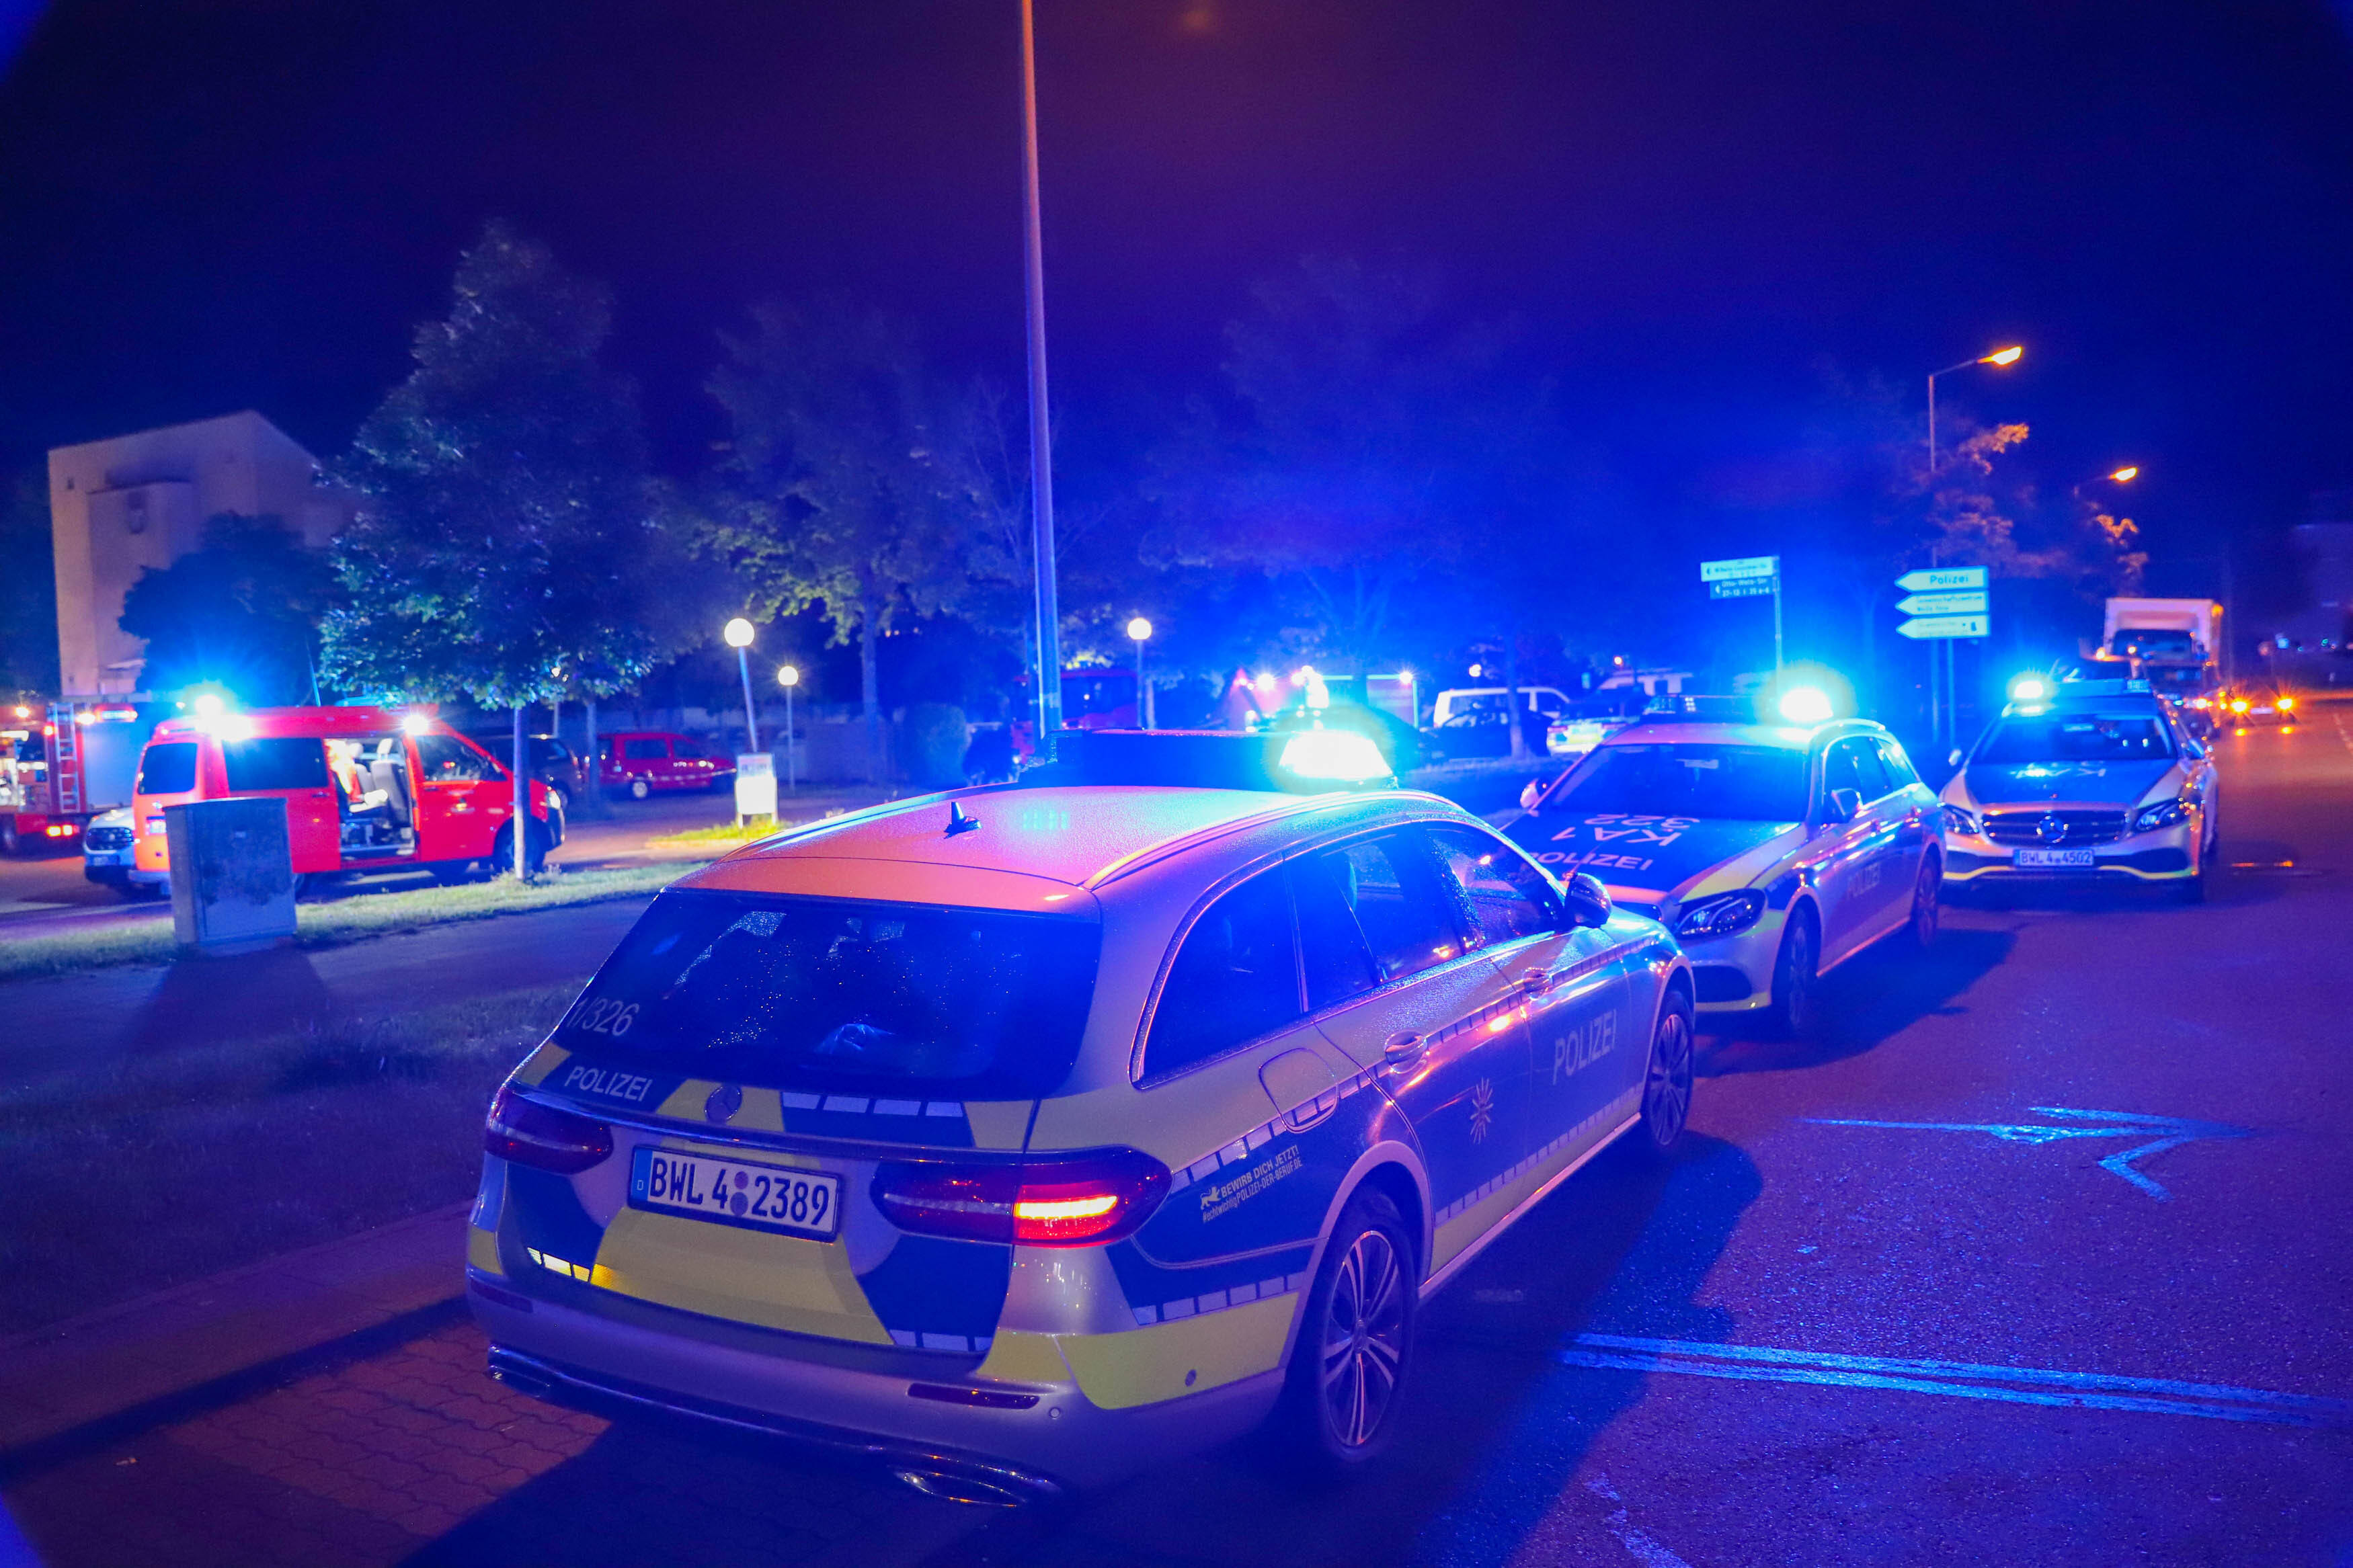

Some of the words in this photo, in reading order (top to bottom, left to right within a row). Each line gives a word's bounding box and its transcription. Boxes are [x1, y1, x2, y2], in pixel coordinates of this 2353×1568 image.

[1929, 575, 1968, 585] Polizei
[1584, 813, 1700, 829] 322
[1594, 827, 1682, 846] KA
[567, 997, 640, 1036] 1/326
[1553, 1009, 1617, 1085] POLIZEI
[564, 1066, 653, 1102] POLIZEI
[637, 1180, 644, 1191] D
[1221, 1172, 1253, 1198] BEWIRB
[1253, 1159, 1273, 1179] DICH
[1275, 1145, 1300, 1166] JETZT!
[650, 1157, 704, 1206] BWL
[712, 1167, 729, 1210] 4
[751, 1174, 830, 1227] 2389
